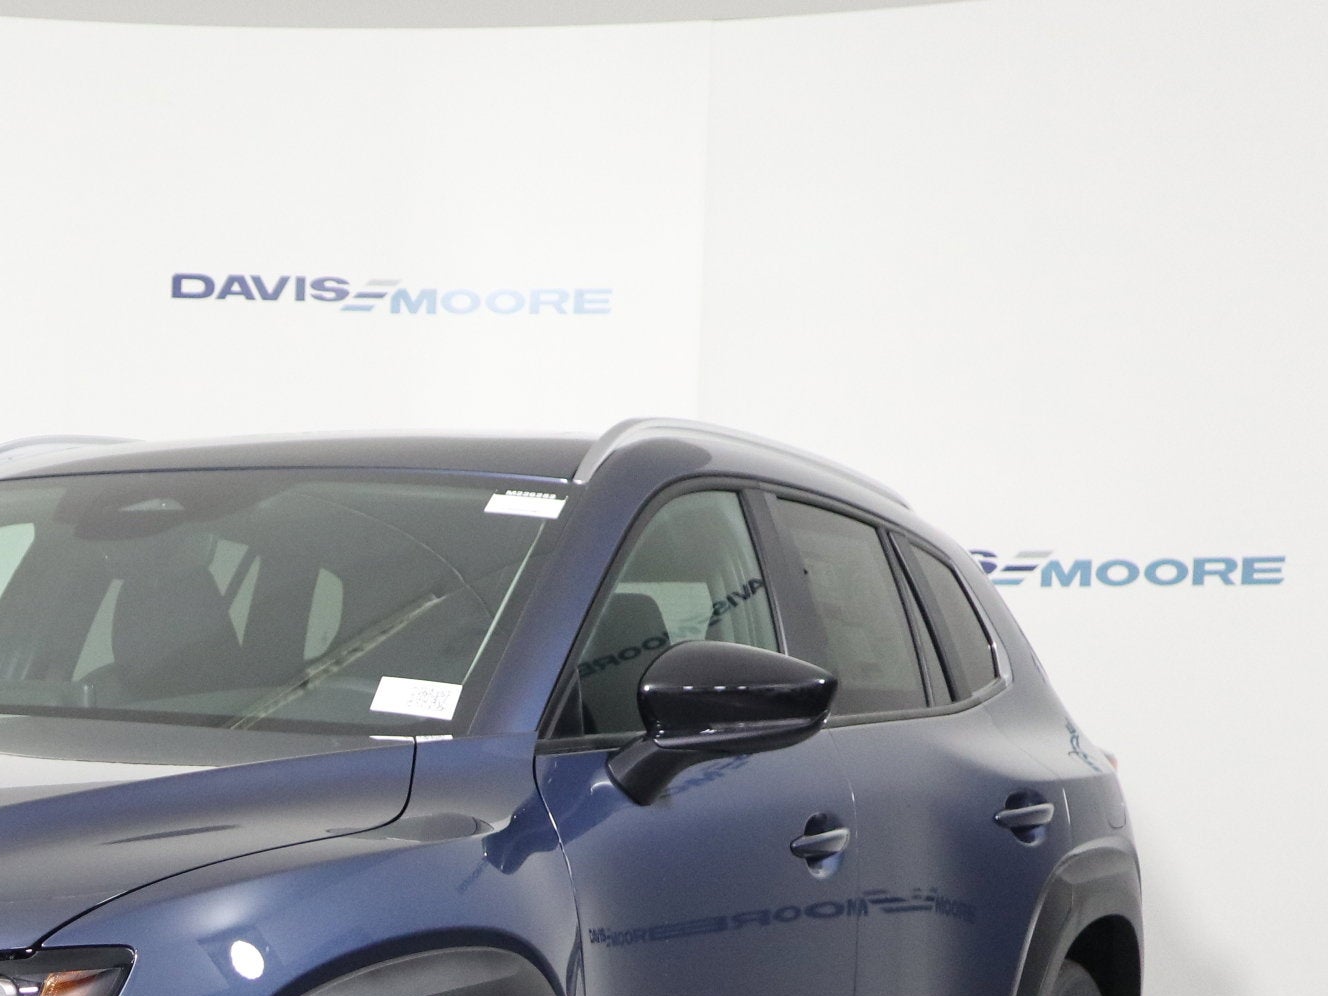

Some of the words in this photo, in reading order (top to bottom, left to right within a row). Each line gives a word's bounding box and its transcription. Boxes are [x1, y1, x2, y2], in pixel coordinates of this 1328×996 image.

[171, 273, 350, 302] DAVIS
[390, 287, 614, 316] MOORE
[1040, 555, 1286, 588] MOORE
